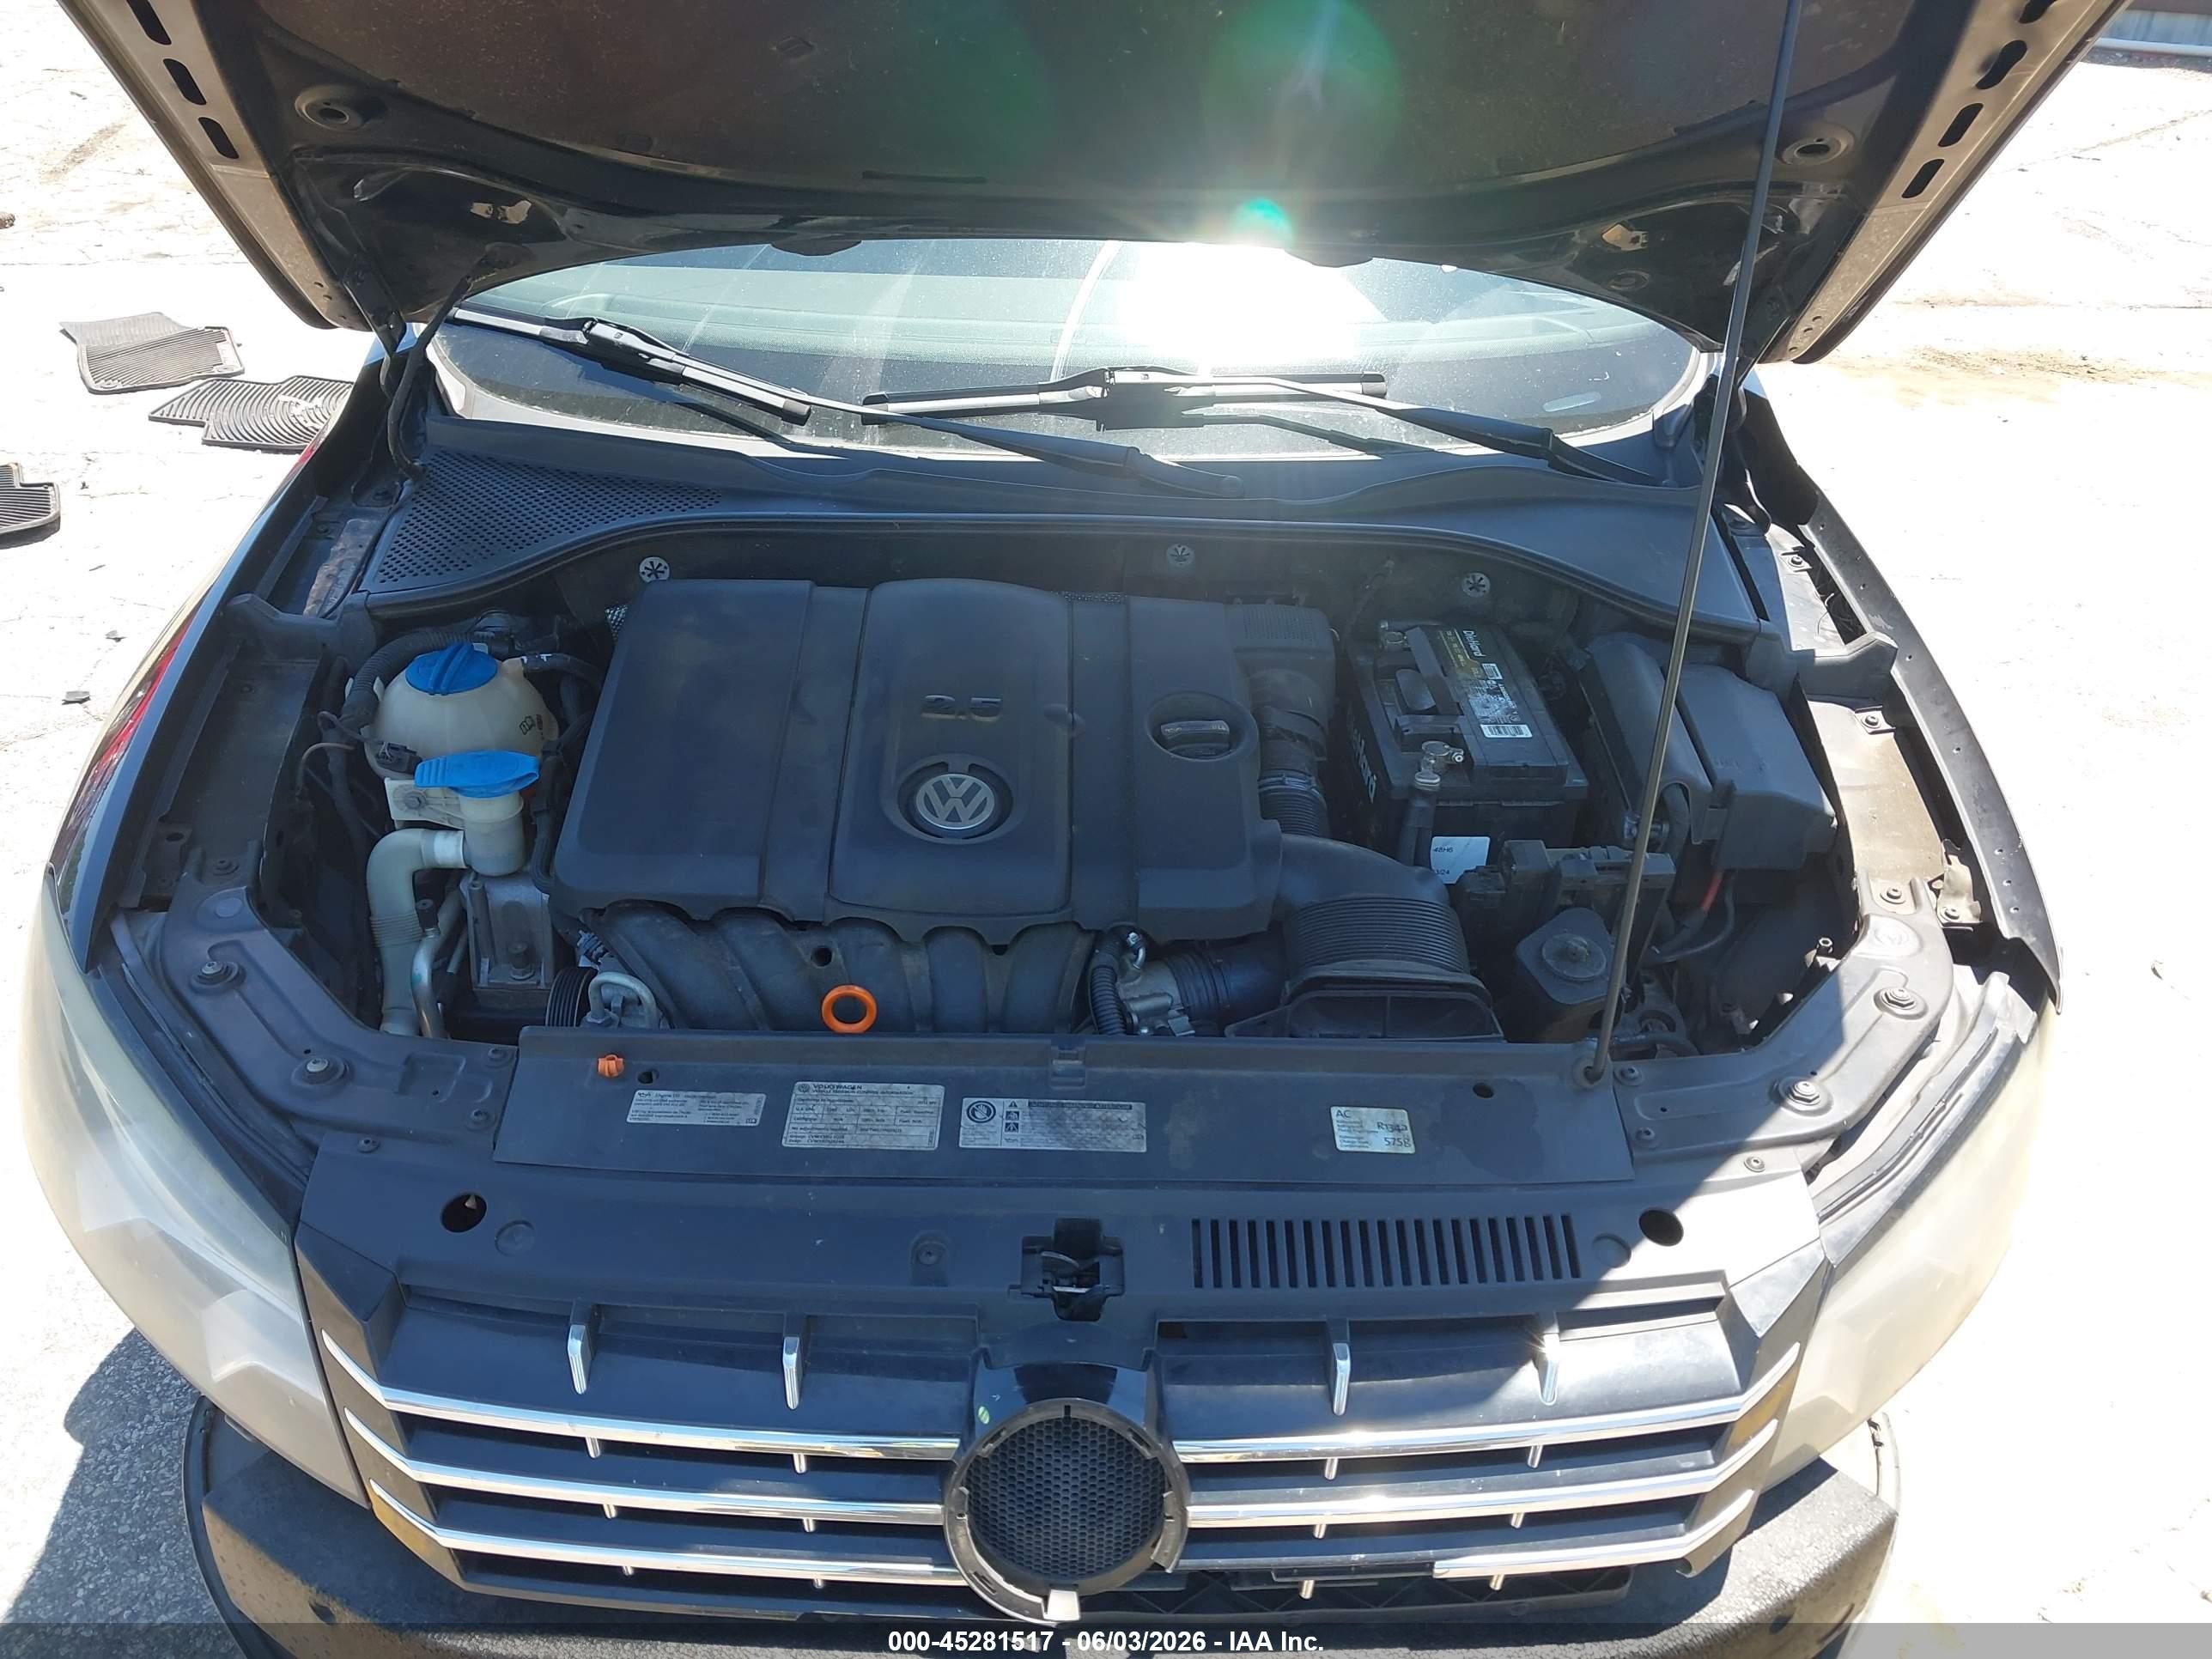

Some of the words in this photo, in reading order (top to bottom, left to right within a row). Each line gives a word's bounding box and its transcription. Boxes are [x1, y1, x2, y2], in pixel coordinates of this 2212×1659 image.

[1462, 630, 1486, 657] DieHard
[921, 694, 1002, 722] 2.5
[1335, 1109, 1352, 1119] AC
[1377, 1121, 1408, 1133] R134a
